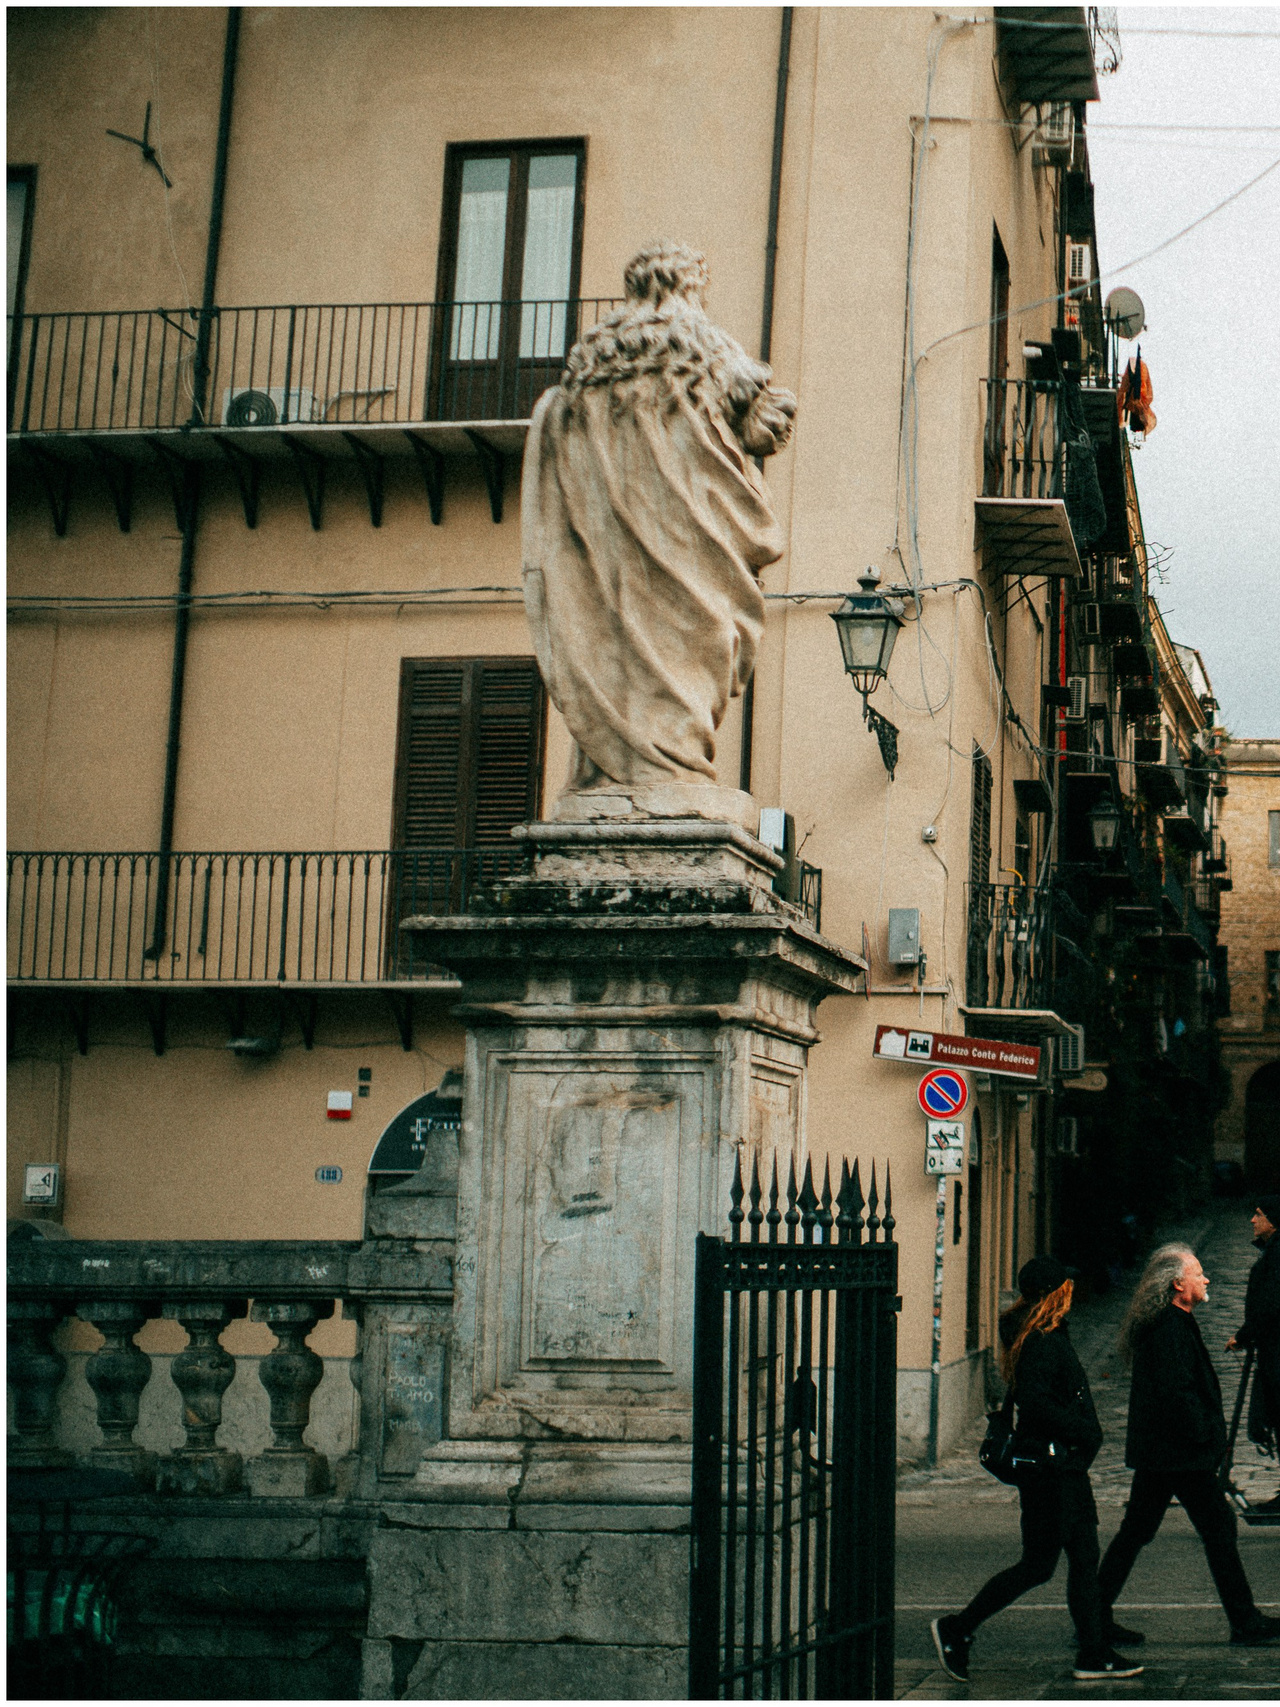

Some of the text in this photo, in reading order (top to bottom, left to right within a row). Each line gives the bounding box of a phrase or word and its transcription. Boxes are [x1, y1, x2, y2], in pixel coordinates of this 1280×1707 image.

[937, 1043, 1035, 1066] Palazzo Conte Federico
[388, 1371, 426, 1387] PAOLO
